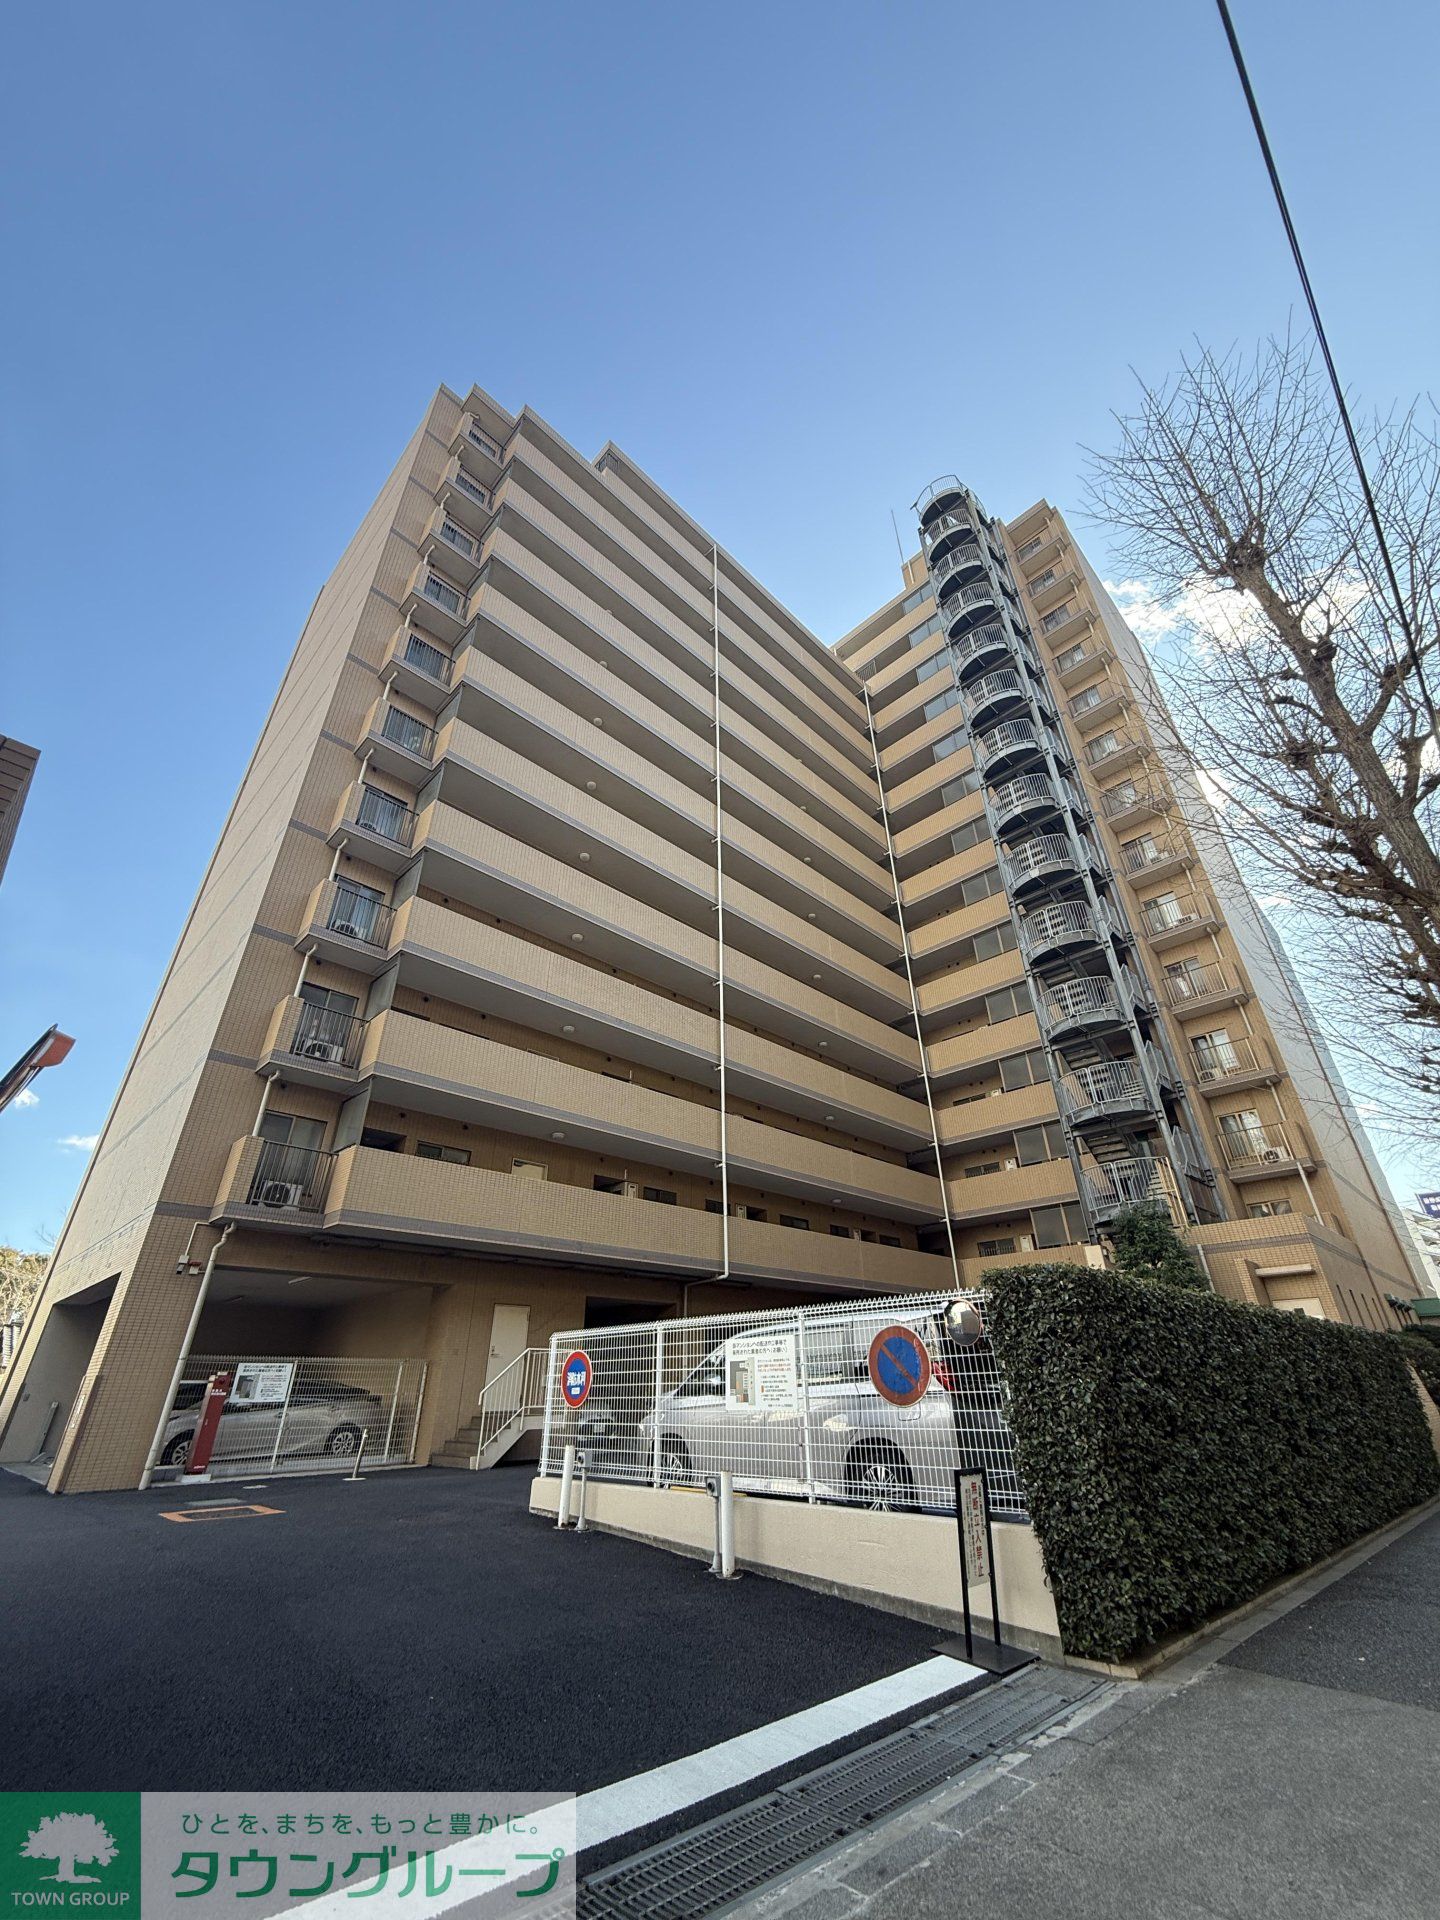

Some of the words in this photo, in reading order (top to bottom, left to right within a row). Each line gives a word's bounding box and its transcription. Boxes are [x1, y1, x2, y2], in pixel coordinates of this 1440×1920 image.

[971, 1482, 984, 1577] 無断立入禁止
